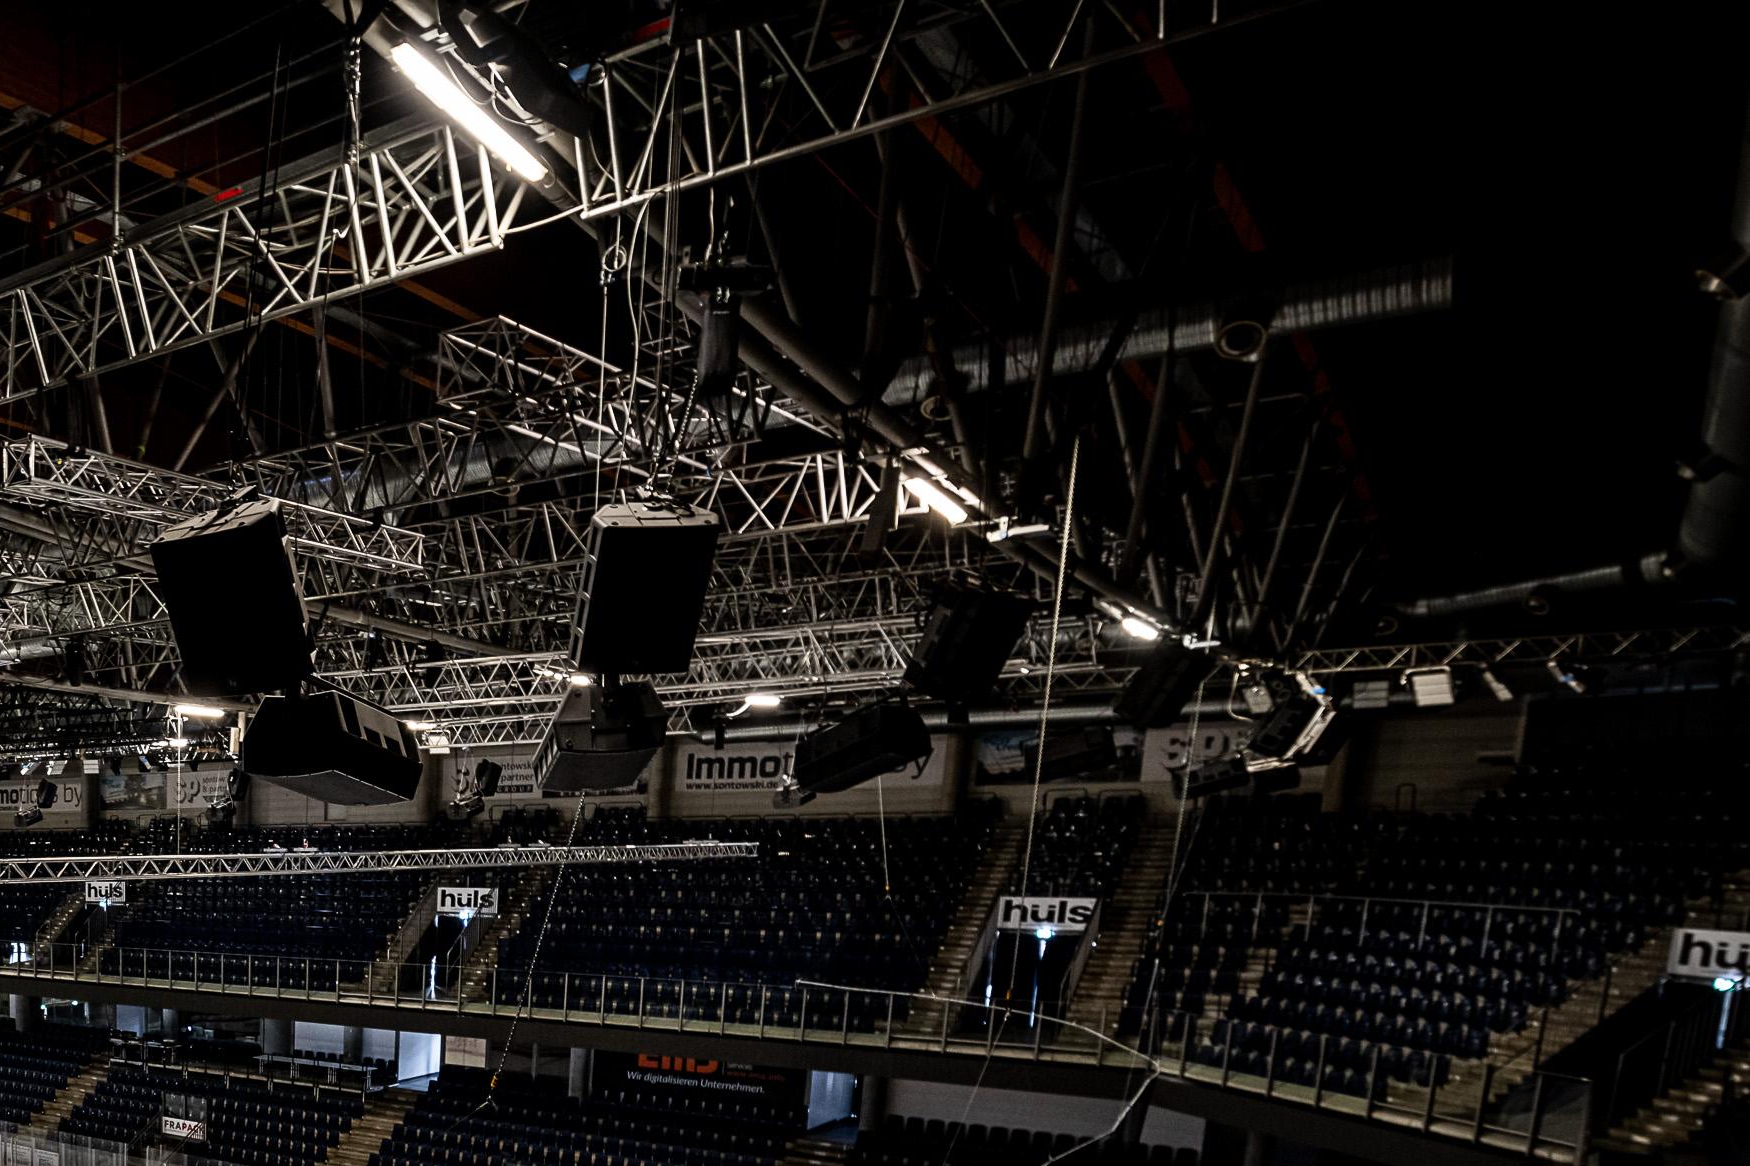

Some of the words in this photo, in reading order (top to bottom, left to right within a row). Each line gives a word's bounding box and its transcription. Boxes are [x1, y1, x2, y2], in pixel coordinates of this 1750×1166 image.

[64, 783, 82, 807] by
[88, 883, 123, 898] hüls
[441, 889, 495, 908] hüls
[1002, 899, 1093, 924] hüls
[626, 1070, 643, 1081] Wir
[643, 1072, 698, 1087] digitalisieren
[700, 1078, 765, 1094] Unternehmen.
